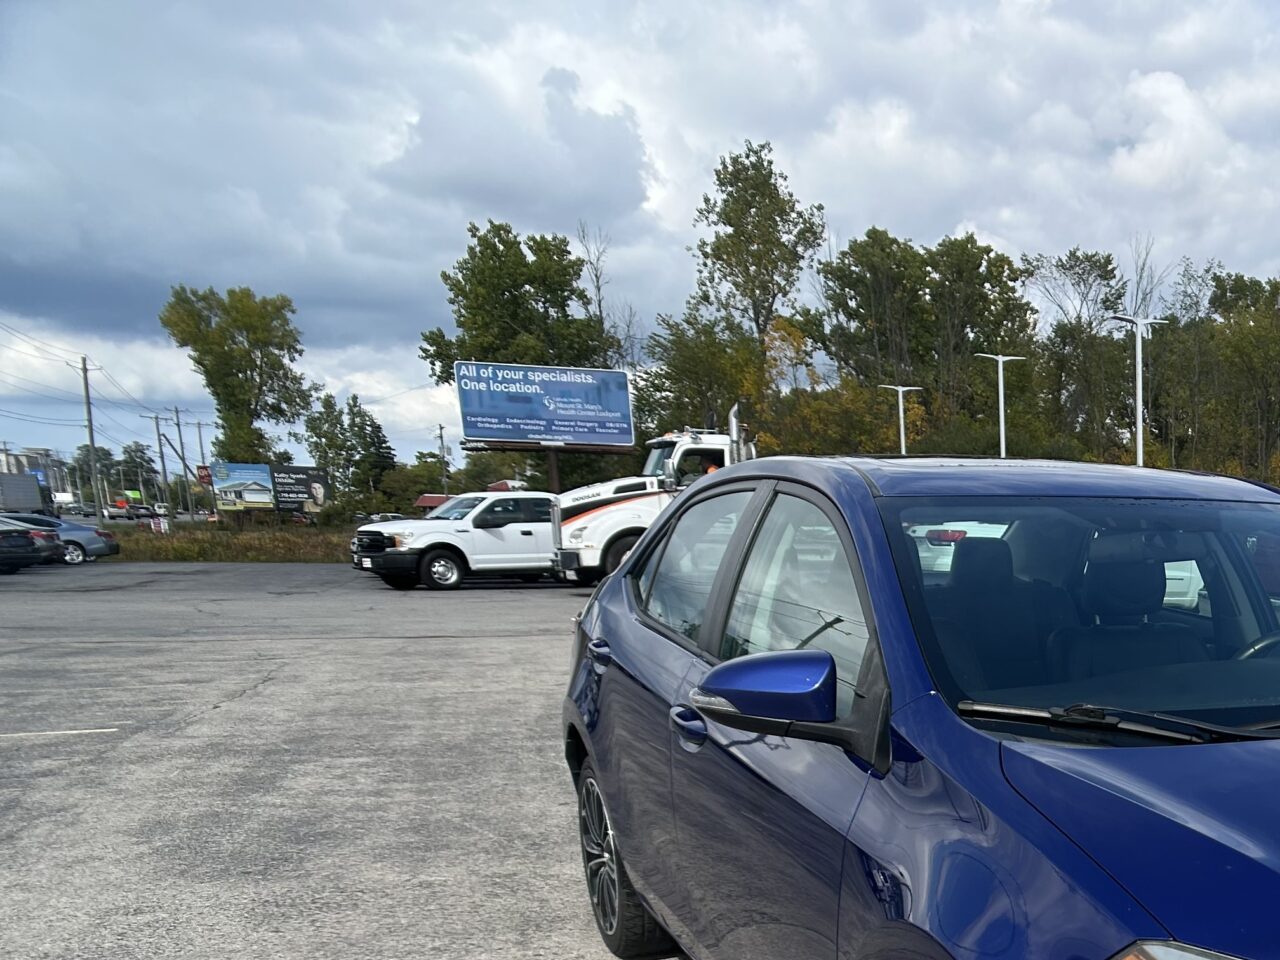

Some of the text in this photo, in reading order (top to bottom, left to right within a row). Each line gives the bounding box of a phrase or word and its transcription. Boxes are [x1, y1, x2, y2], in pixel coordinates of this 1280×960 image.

[459, 365, 598, 384] All of your specialists.
[461, 379, 545, 394] One location.
[466, 416, 499, 424] Cardiology
